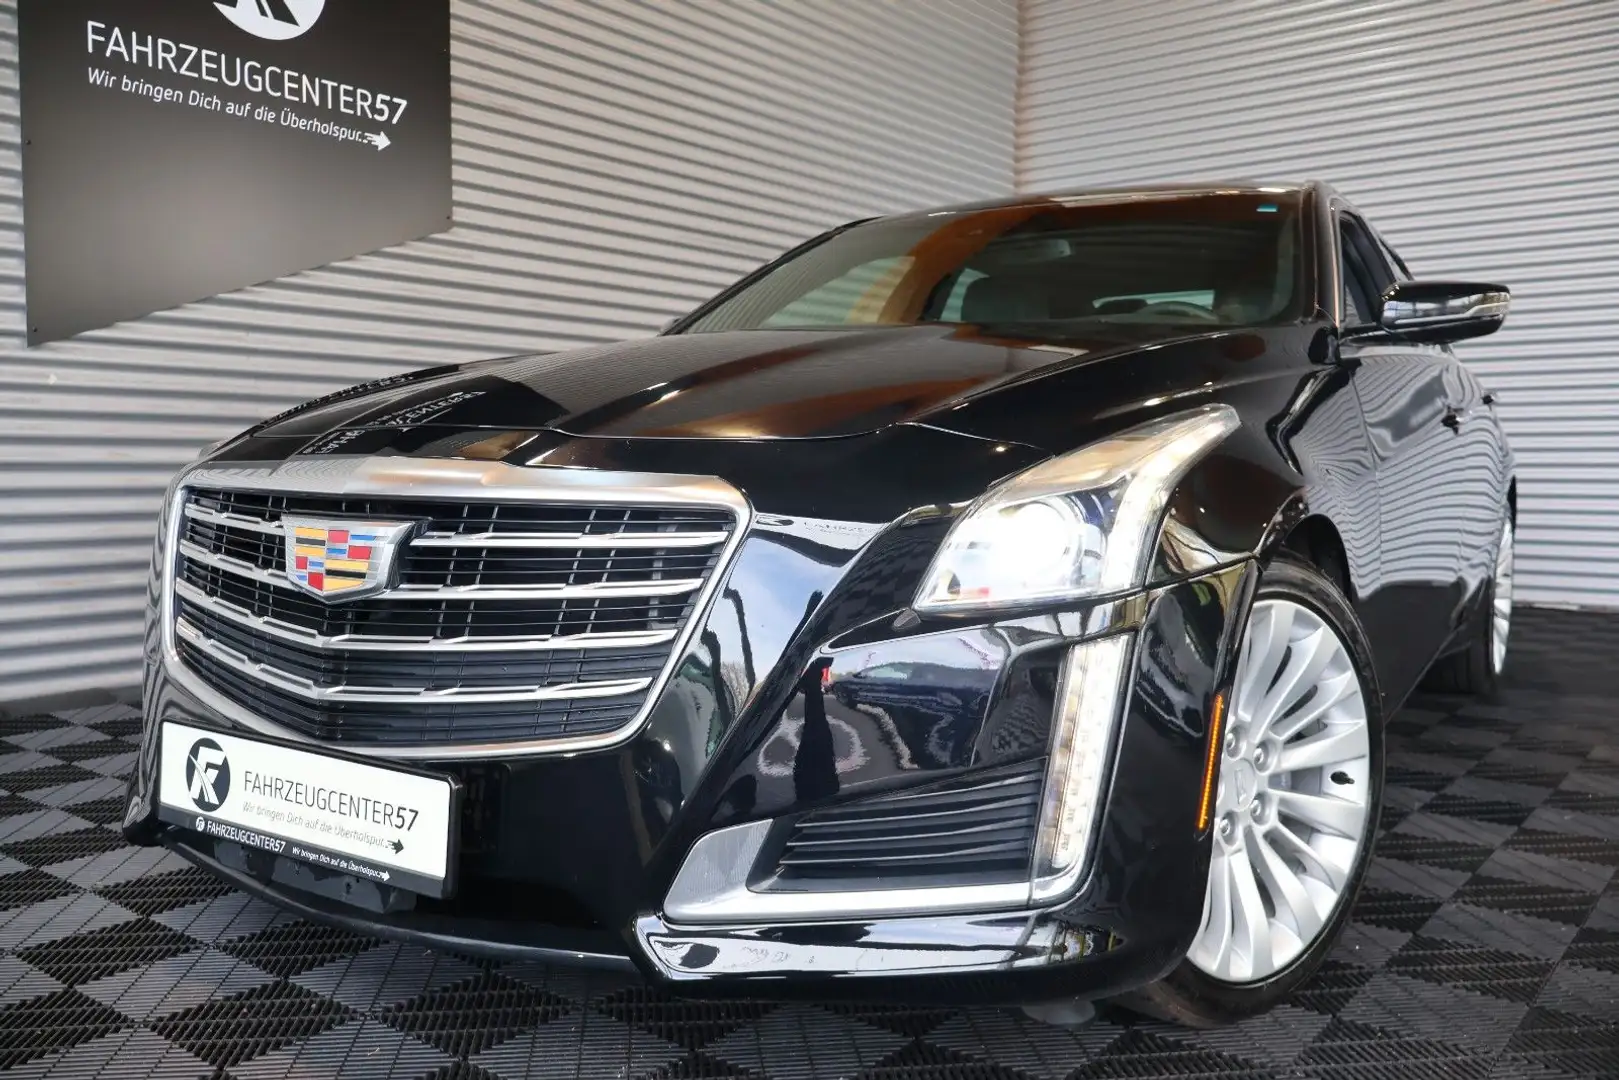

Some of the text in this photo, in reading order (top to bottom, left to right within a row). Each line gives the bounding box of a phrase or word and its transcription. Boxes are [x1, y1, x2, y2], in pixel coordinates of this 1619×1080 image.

[86, 20, 408, 125] FAHRZEUGCENTER57
[88, 66, 117, 89] Wir
[121, 75, 184, 103] bringen
[188, 90, 221, 111] Dich
[225, 101, 252, 118] auf
[254, 106, 277, 123] die
[242, 801, 255, 813] Wir
[256, 805, 285, 822] bringen
[287, 811, 304, 826] Dich
[305, 817, 320, 830] auf
[321, 822, 334, 834] die
[243, 770, 420, 832] FAHRZEUGCENTER57
[206, 820, 287, 853] FAHRZEUGCENTER57
